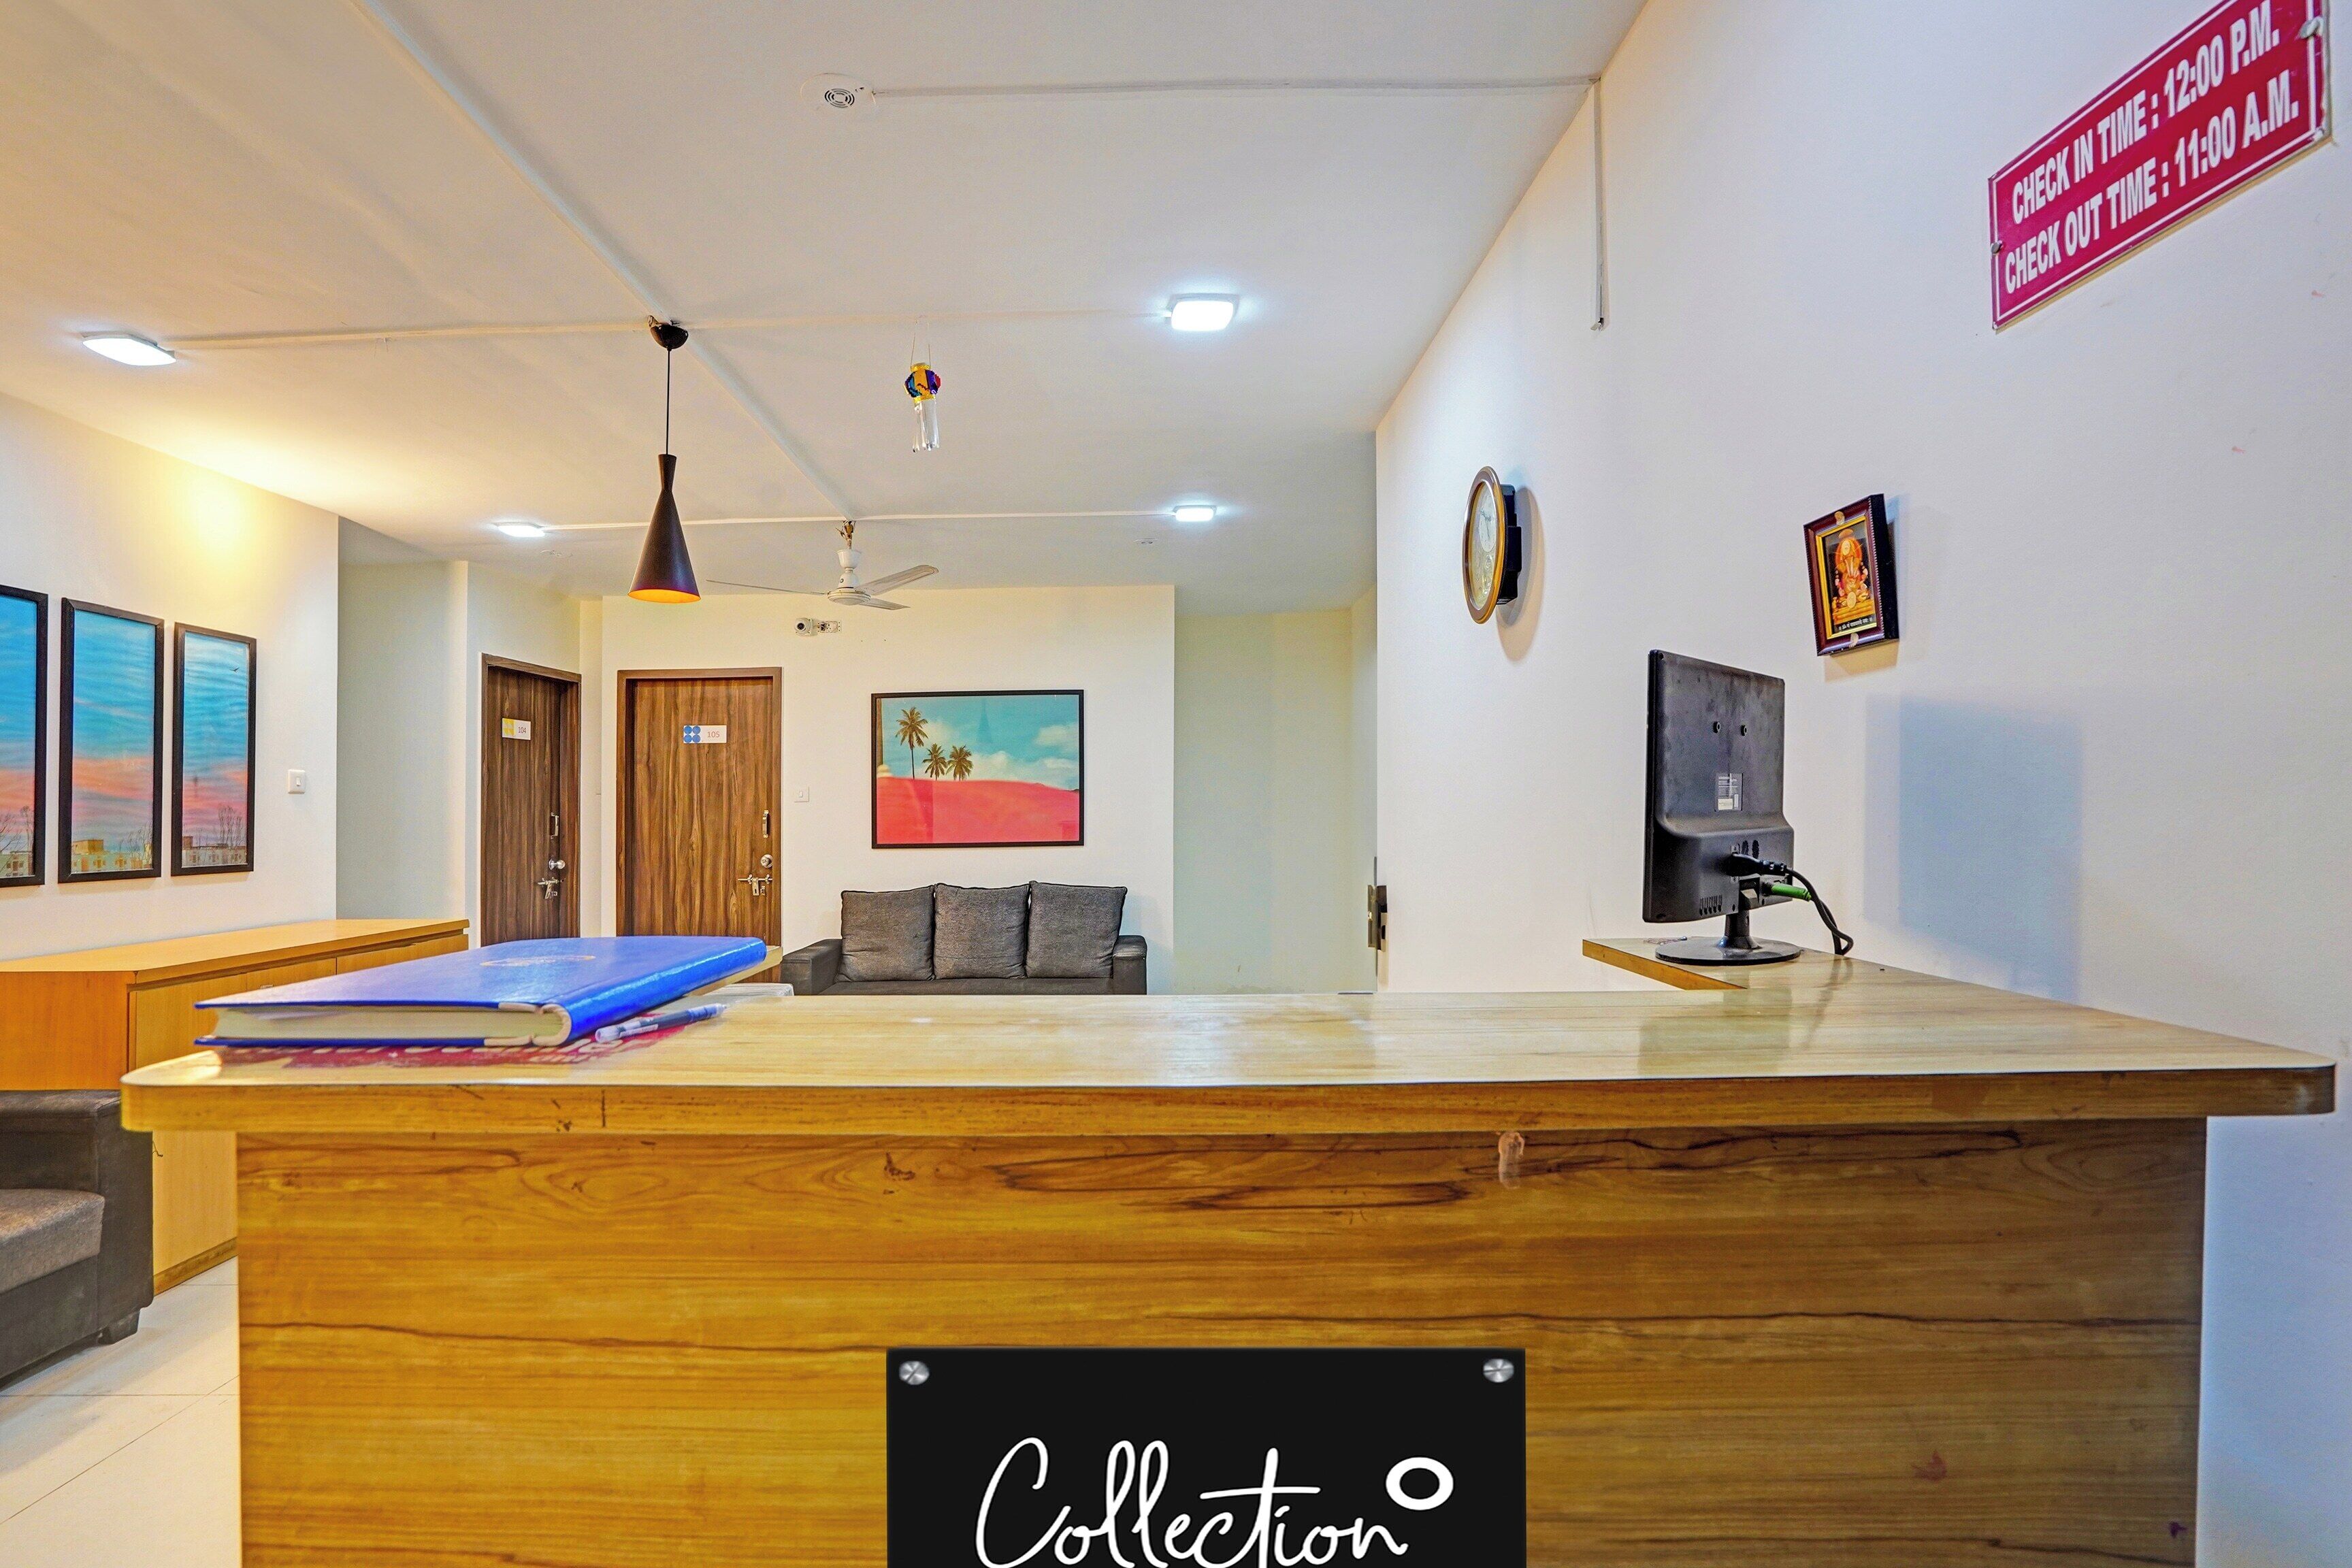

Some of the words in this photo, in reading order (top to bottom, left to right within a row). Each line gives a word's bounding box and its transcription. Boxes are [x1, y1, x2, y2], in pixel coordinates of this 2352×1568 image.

[2005, 220, 2061, 294] CHECK
[2064, 191, 2104, 257] OUT
[2174, 105, 2236, 187] 11:00
[2242, 69, 2299, 149] A.M.
[2012, 145, 2070, 225] CHECK
[2074, 128, 2094, 183] IN
[2163, 33, 2225, 118] 12:00
[2230, 0, 2280, 75] P.M.
[975, 1437, 1409, 1568] Collection
